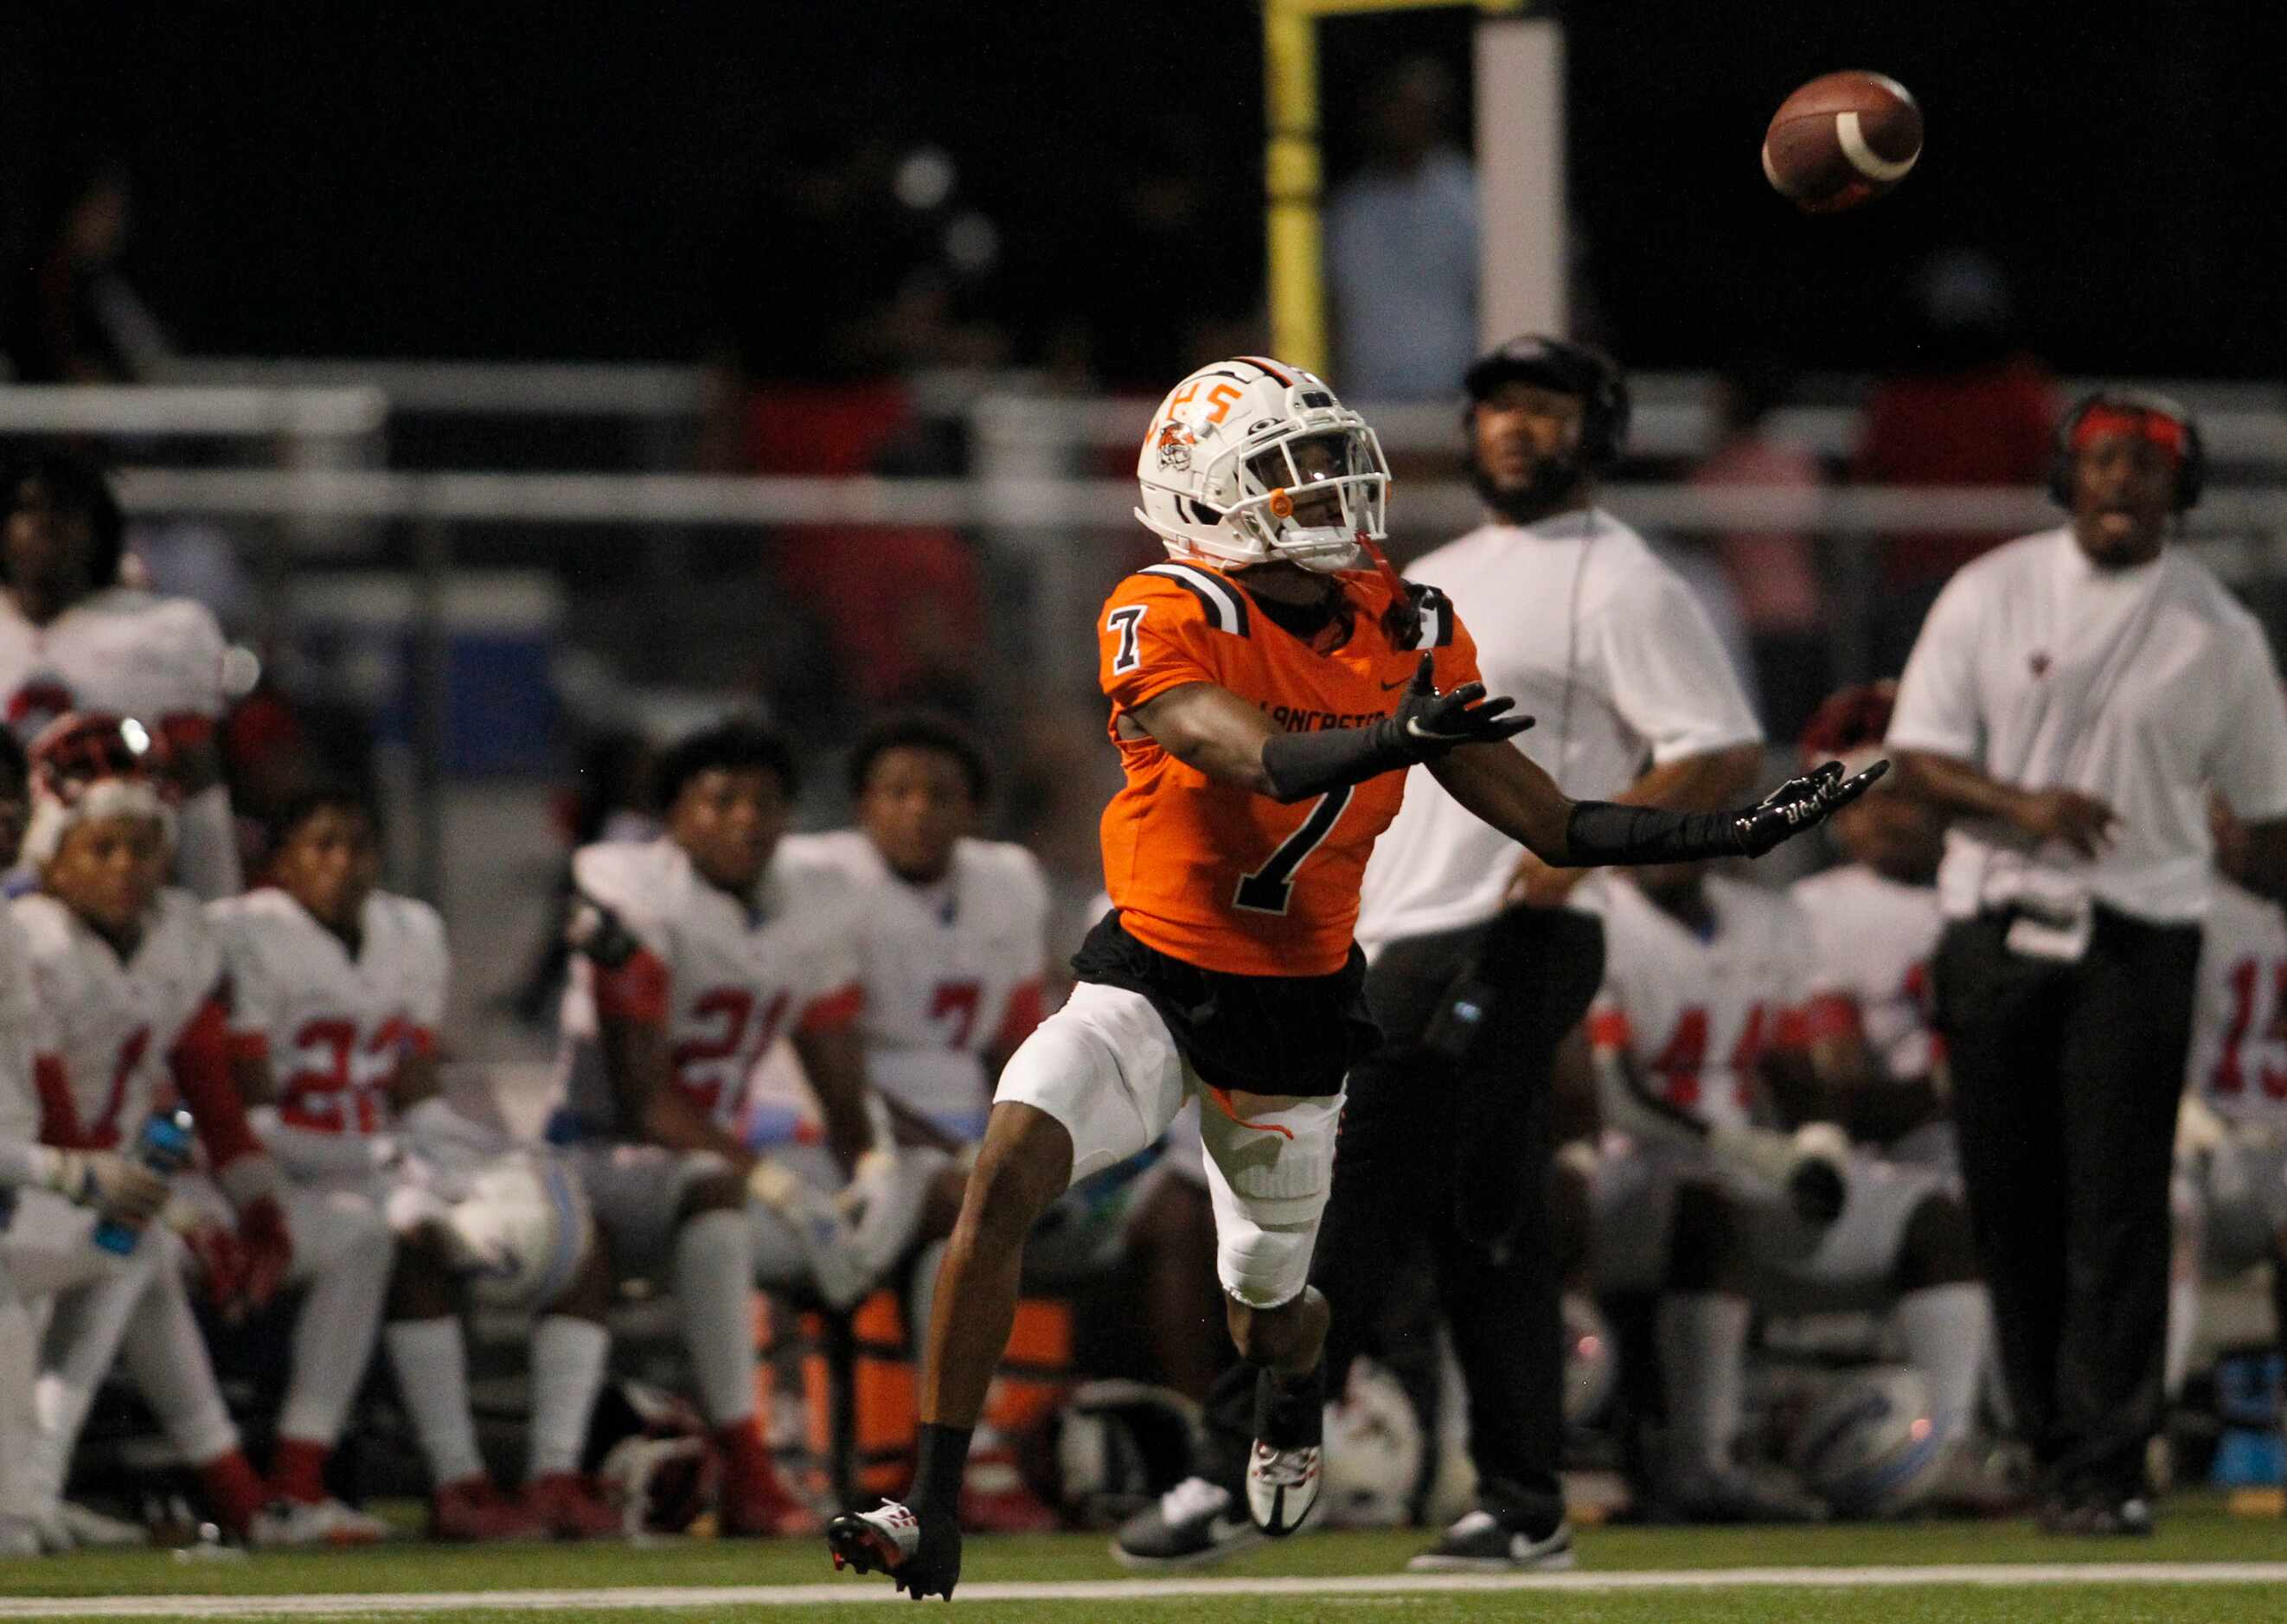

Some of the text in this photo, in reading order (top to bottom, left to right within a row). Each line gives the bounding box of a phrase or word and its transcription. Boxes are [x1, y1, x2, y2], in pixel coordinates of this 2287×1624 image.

[1106, 604, 1150, 676] 7
[1260, 700, 1385, 732] ANCAST
[925, 979, 983, 1052] 7
